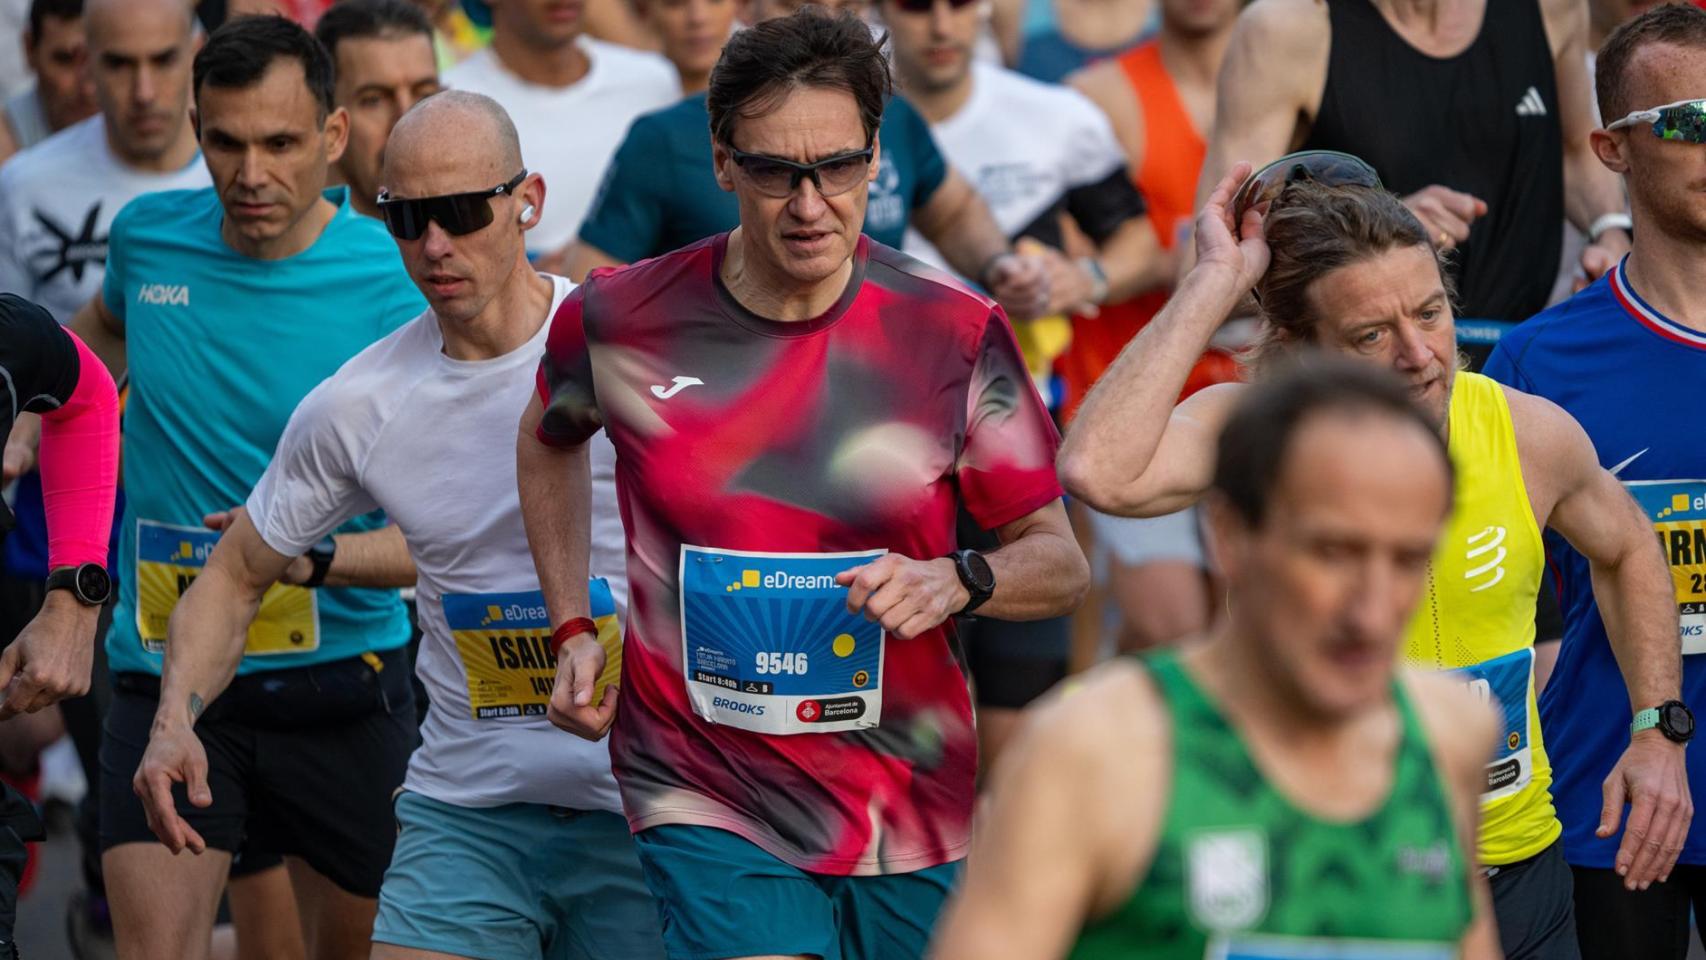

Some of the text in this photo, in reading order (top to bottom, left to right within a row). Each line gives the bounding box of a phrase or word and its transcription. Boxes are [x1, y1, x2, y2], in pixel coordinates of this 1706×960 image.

[138, 284, 189, 306] HOKA
[755, 651, 808, 675] 9546
[698, 672, 717, 684] Start
[713, 697, 766, 716] BROOKS
[825, 709, 858, 717] Barcelona
